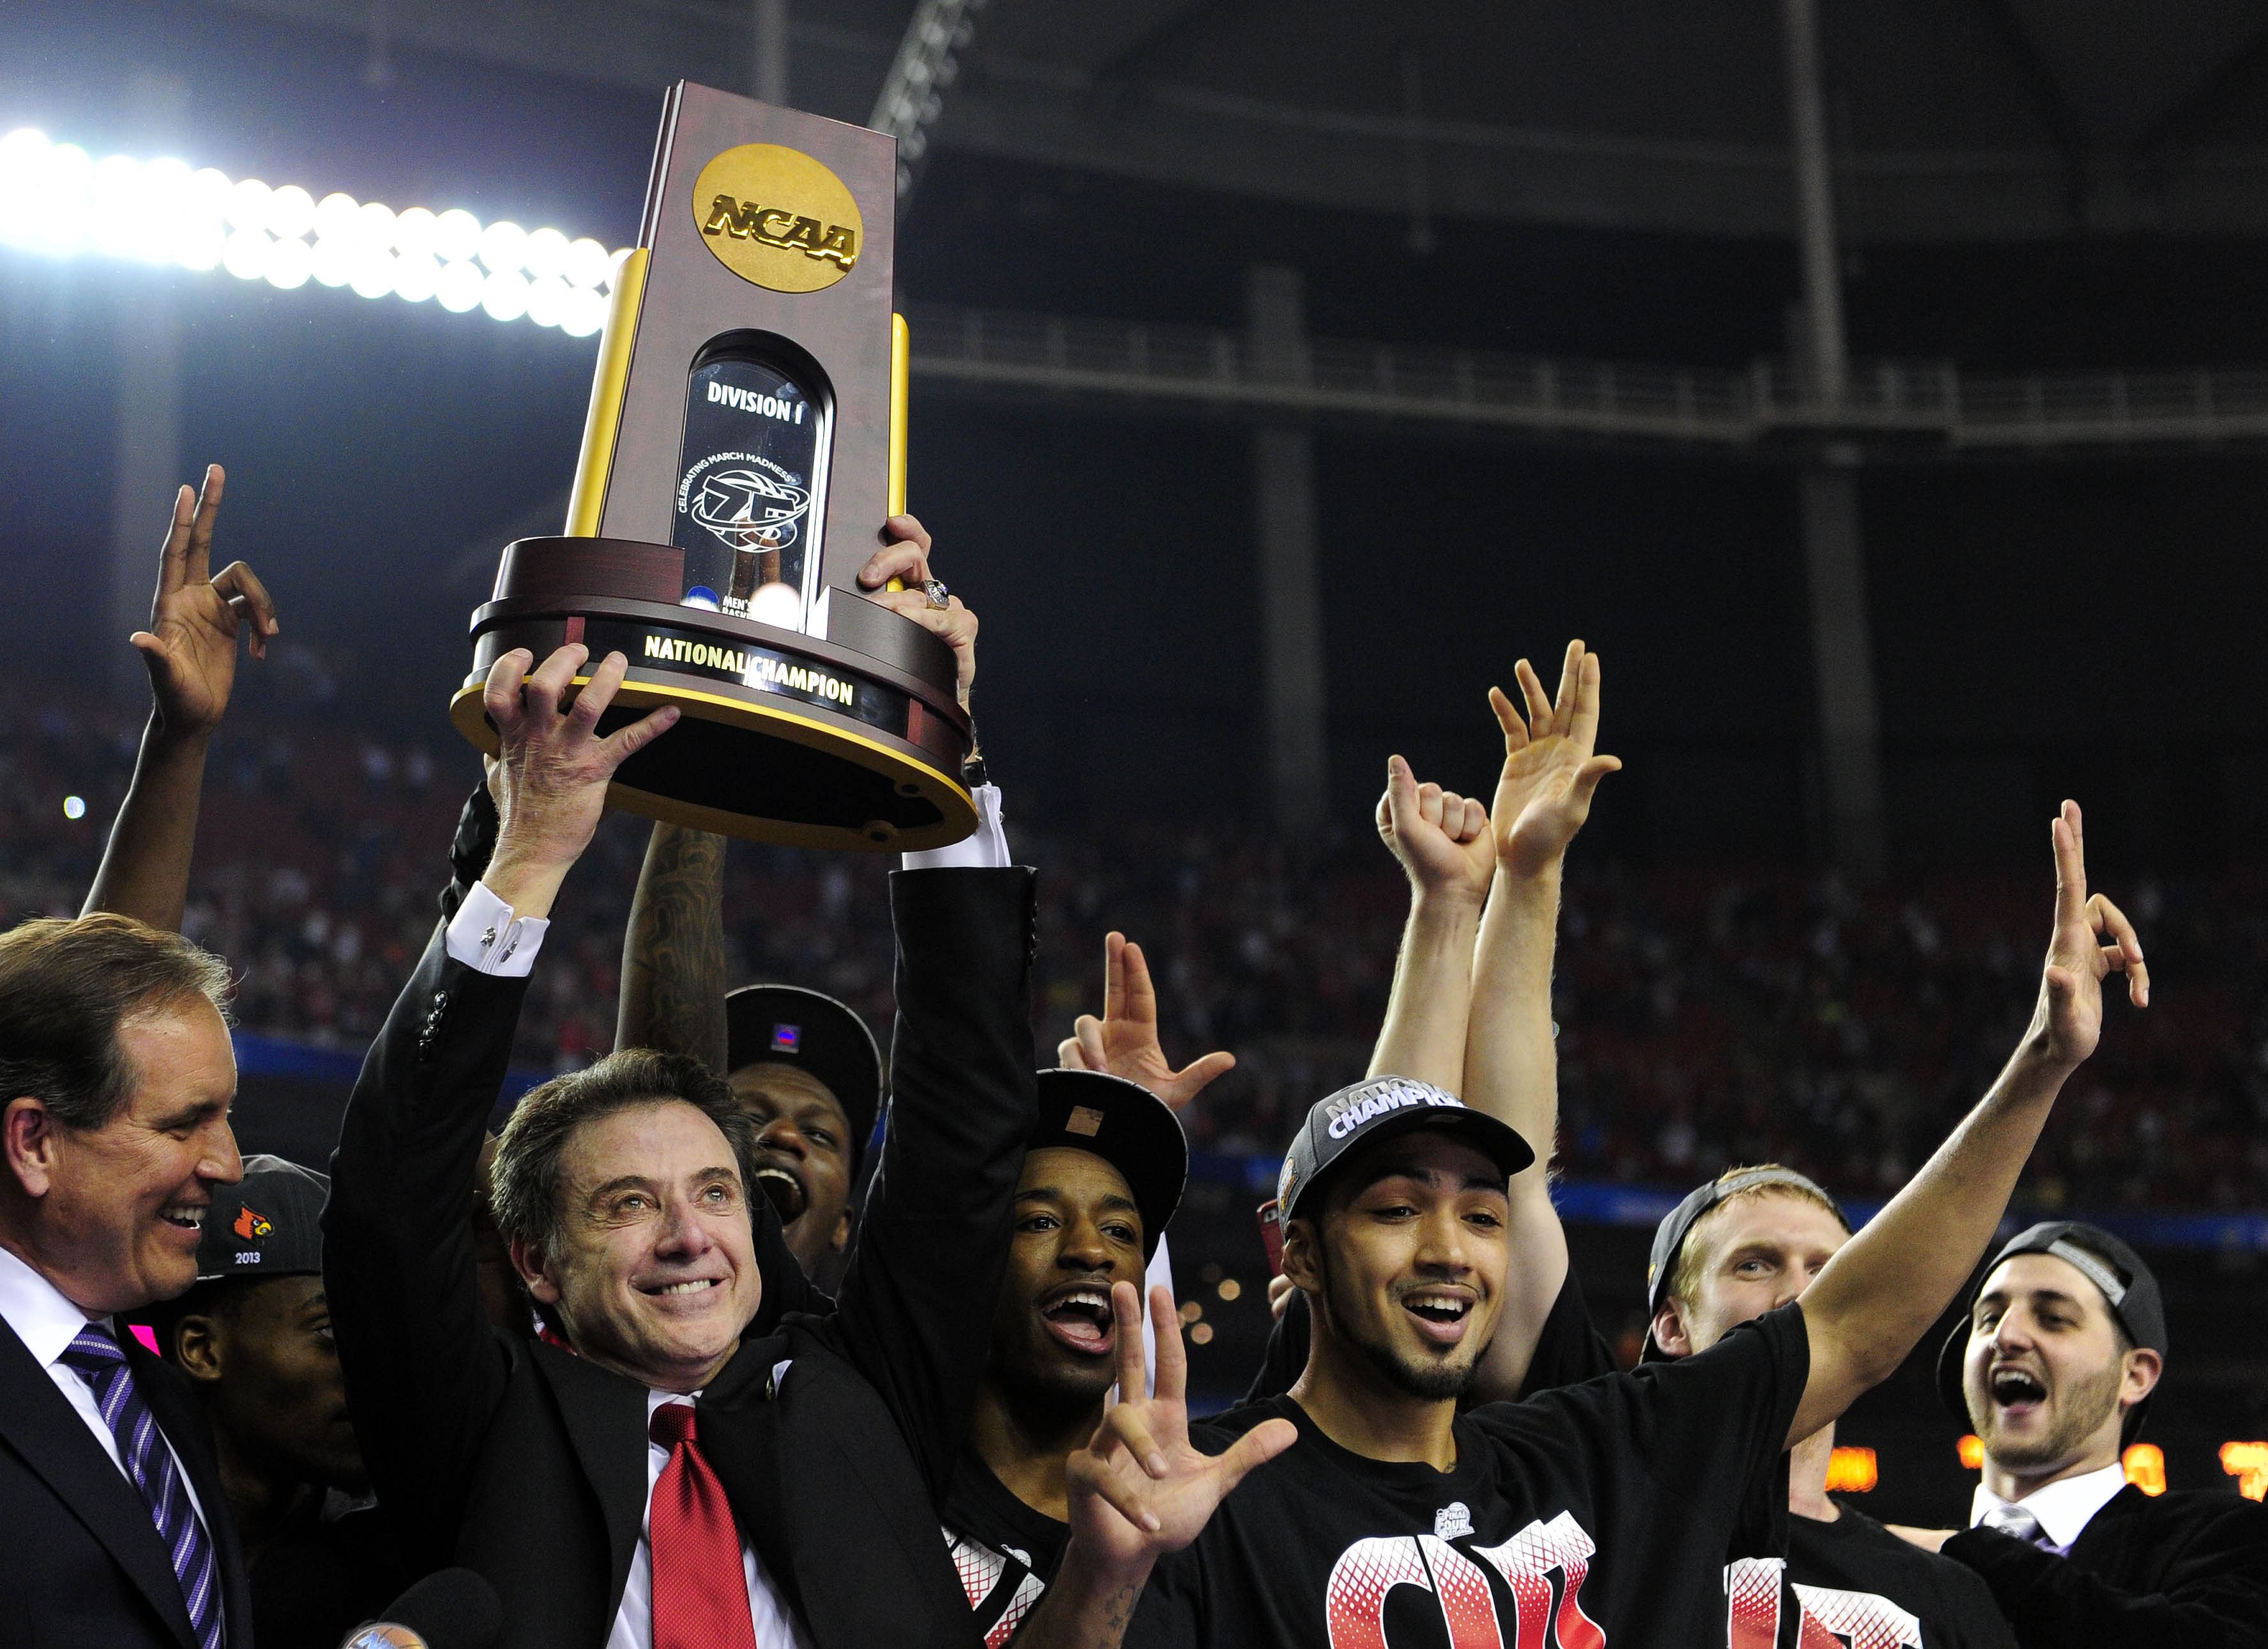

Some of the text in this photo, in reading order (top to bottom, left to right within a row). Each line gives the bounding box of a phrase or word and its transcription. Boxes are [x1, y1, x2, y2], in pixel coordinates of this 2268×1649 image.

[703, 194, 855, 273] NCAA
[707, 381, 803, 425] DIVISION I
[678, 458, 709, 514] CELEBRATING
[707, 451, 745, 465] MARCH
[644, 635, 853, 706] NATIONAL CHAMPION
[1328, 1087, 1467, 1140] CHAMPIO
[235, 1251, 261, 1264] 2013
[1437, 1518, 1467, 1532] FOUR
